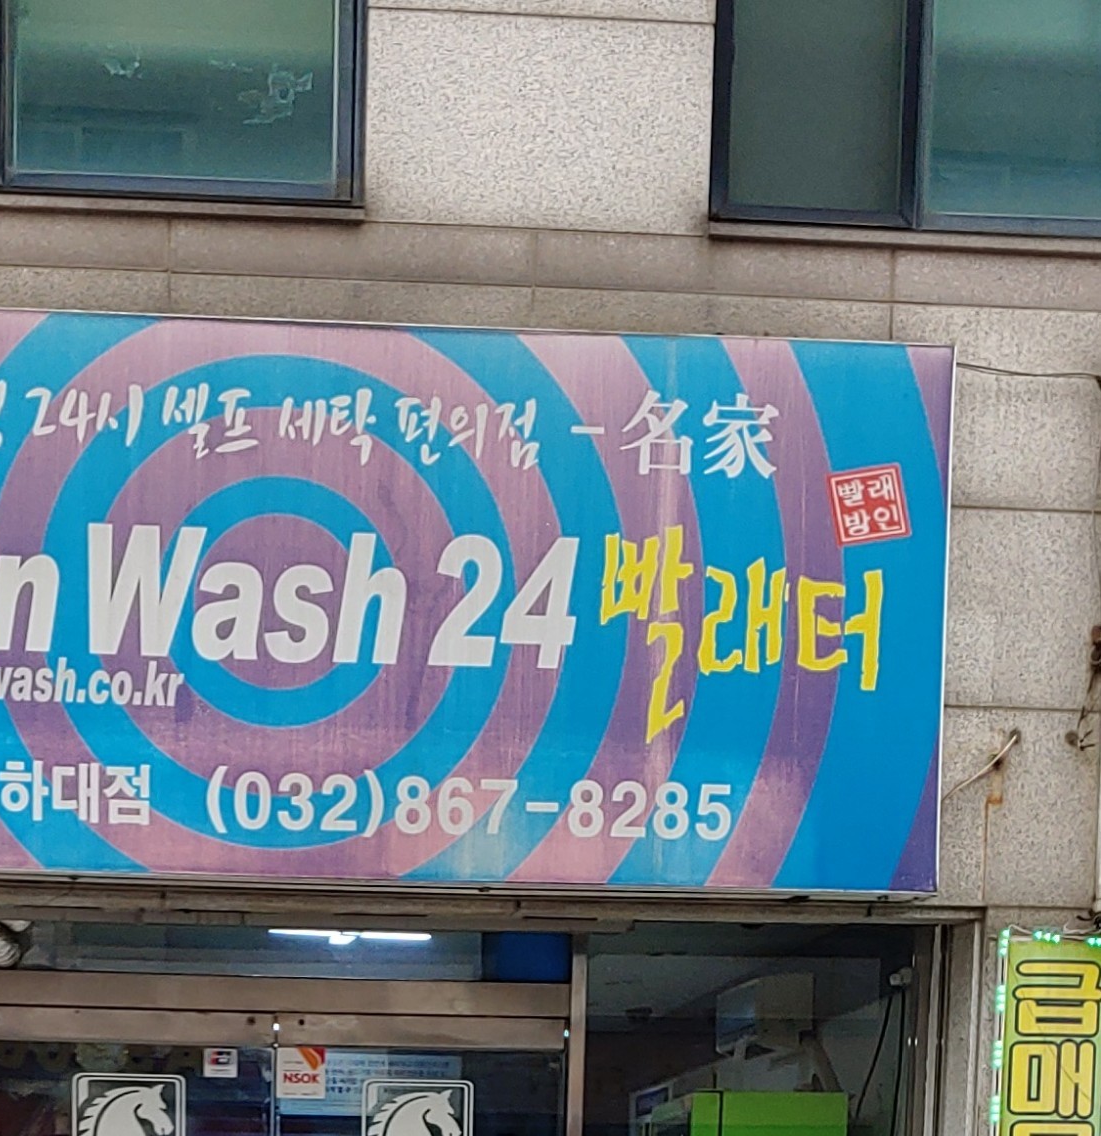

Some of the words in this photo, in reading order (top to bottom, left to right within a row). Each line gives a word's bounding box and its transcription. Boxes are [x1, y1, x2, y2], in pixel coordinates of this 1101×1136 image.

[25, 383, 143, 447] 24시
[162, 383, 259, 459] 셀프
[279, 387, 374, 466] 세탁
[396, 395, 540, 470] 편의점
[619, 391, 780, 480] 名家
[87, 521, 408, 667] Wash
[427, 534, 581, 670] 24
[599, 525, 885, 744] 빨래터
[206, 764, 733, 840] (032)867-8285
[283, 1072, 320, 1084] NSOK
